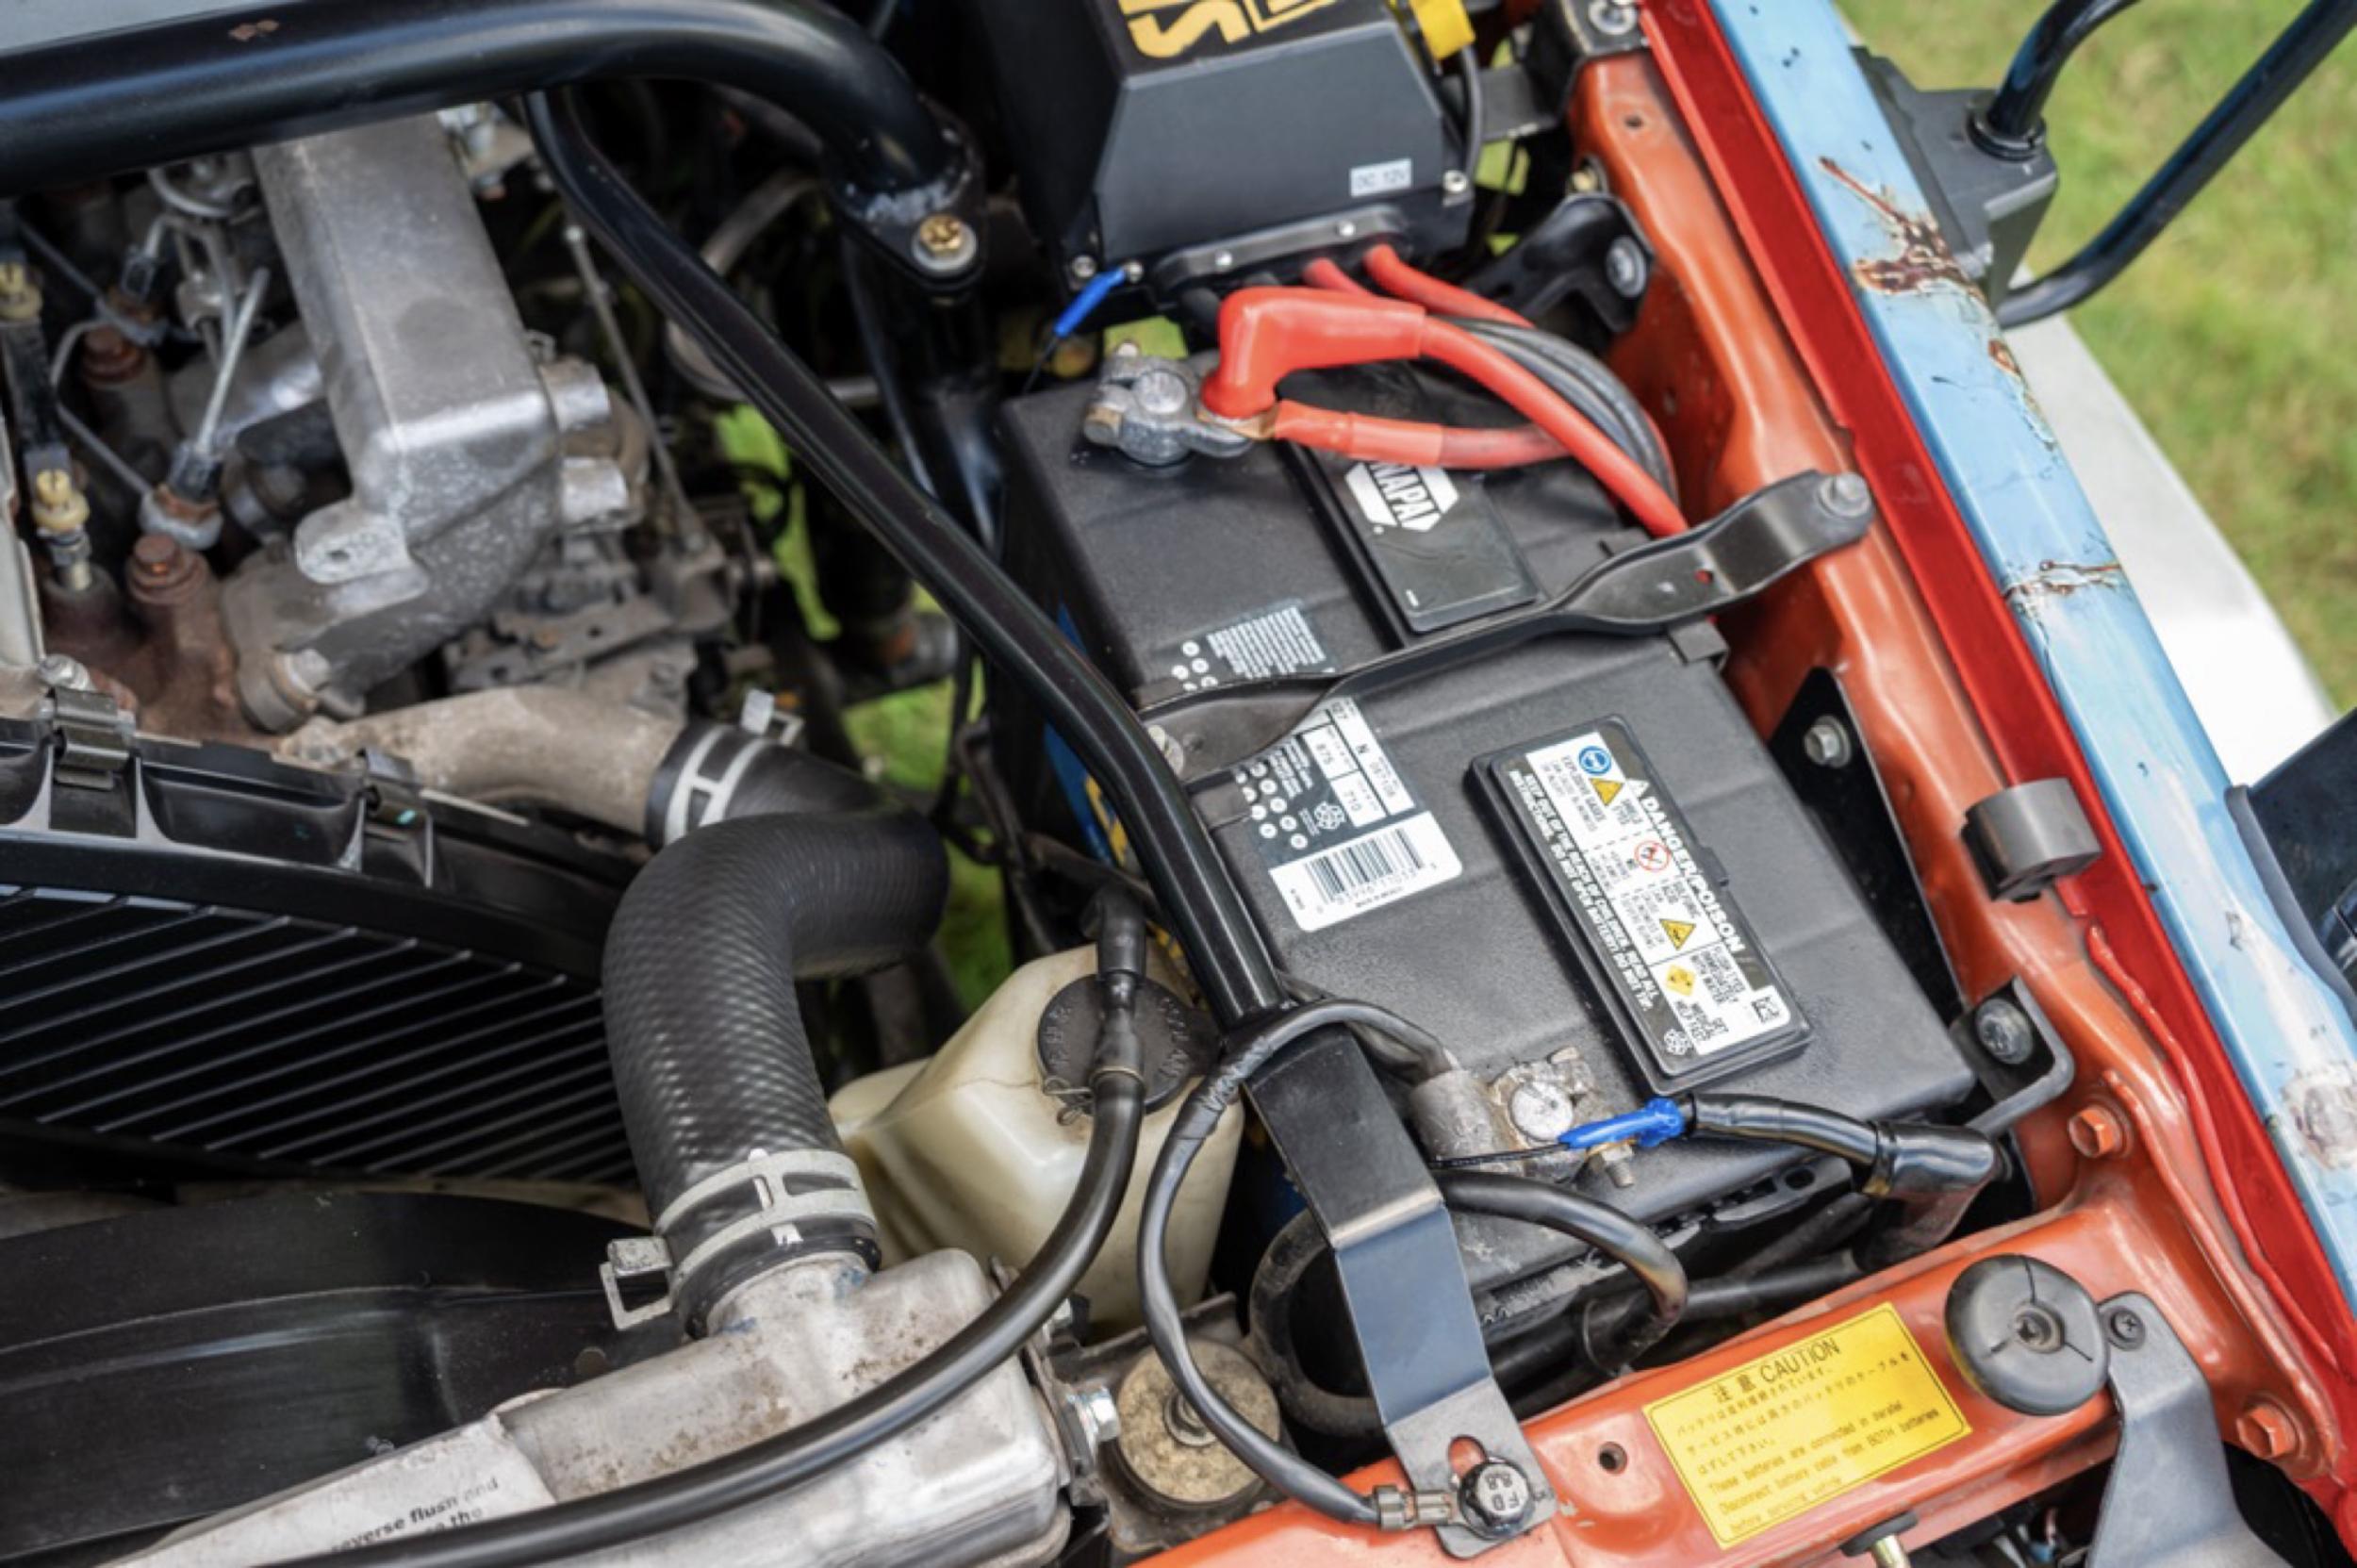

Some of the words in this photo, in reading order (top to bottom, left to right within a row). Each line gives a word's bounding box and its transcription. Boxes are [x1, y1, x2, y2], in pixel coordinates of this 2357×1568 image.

[1638, 795, 1748, 955] DANGER/POISON
[1709, 1372, 1756, 1405] 注意
[1755, 1335, 1842, 1385] CAUTION
[1865, 1425, 1897, 1447] BOTH
